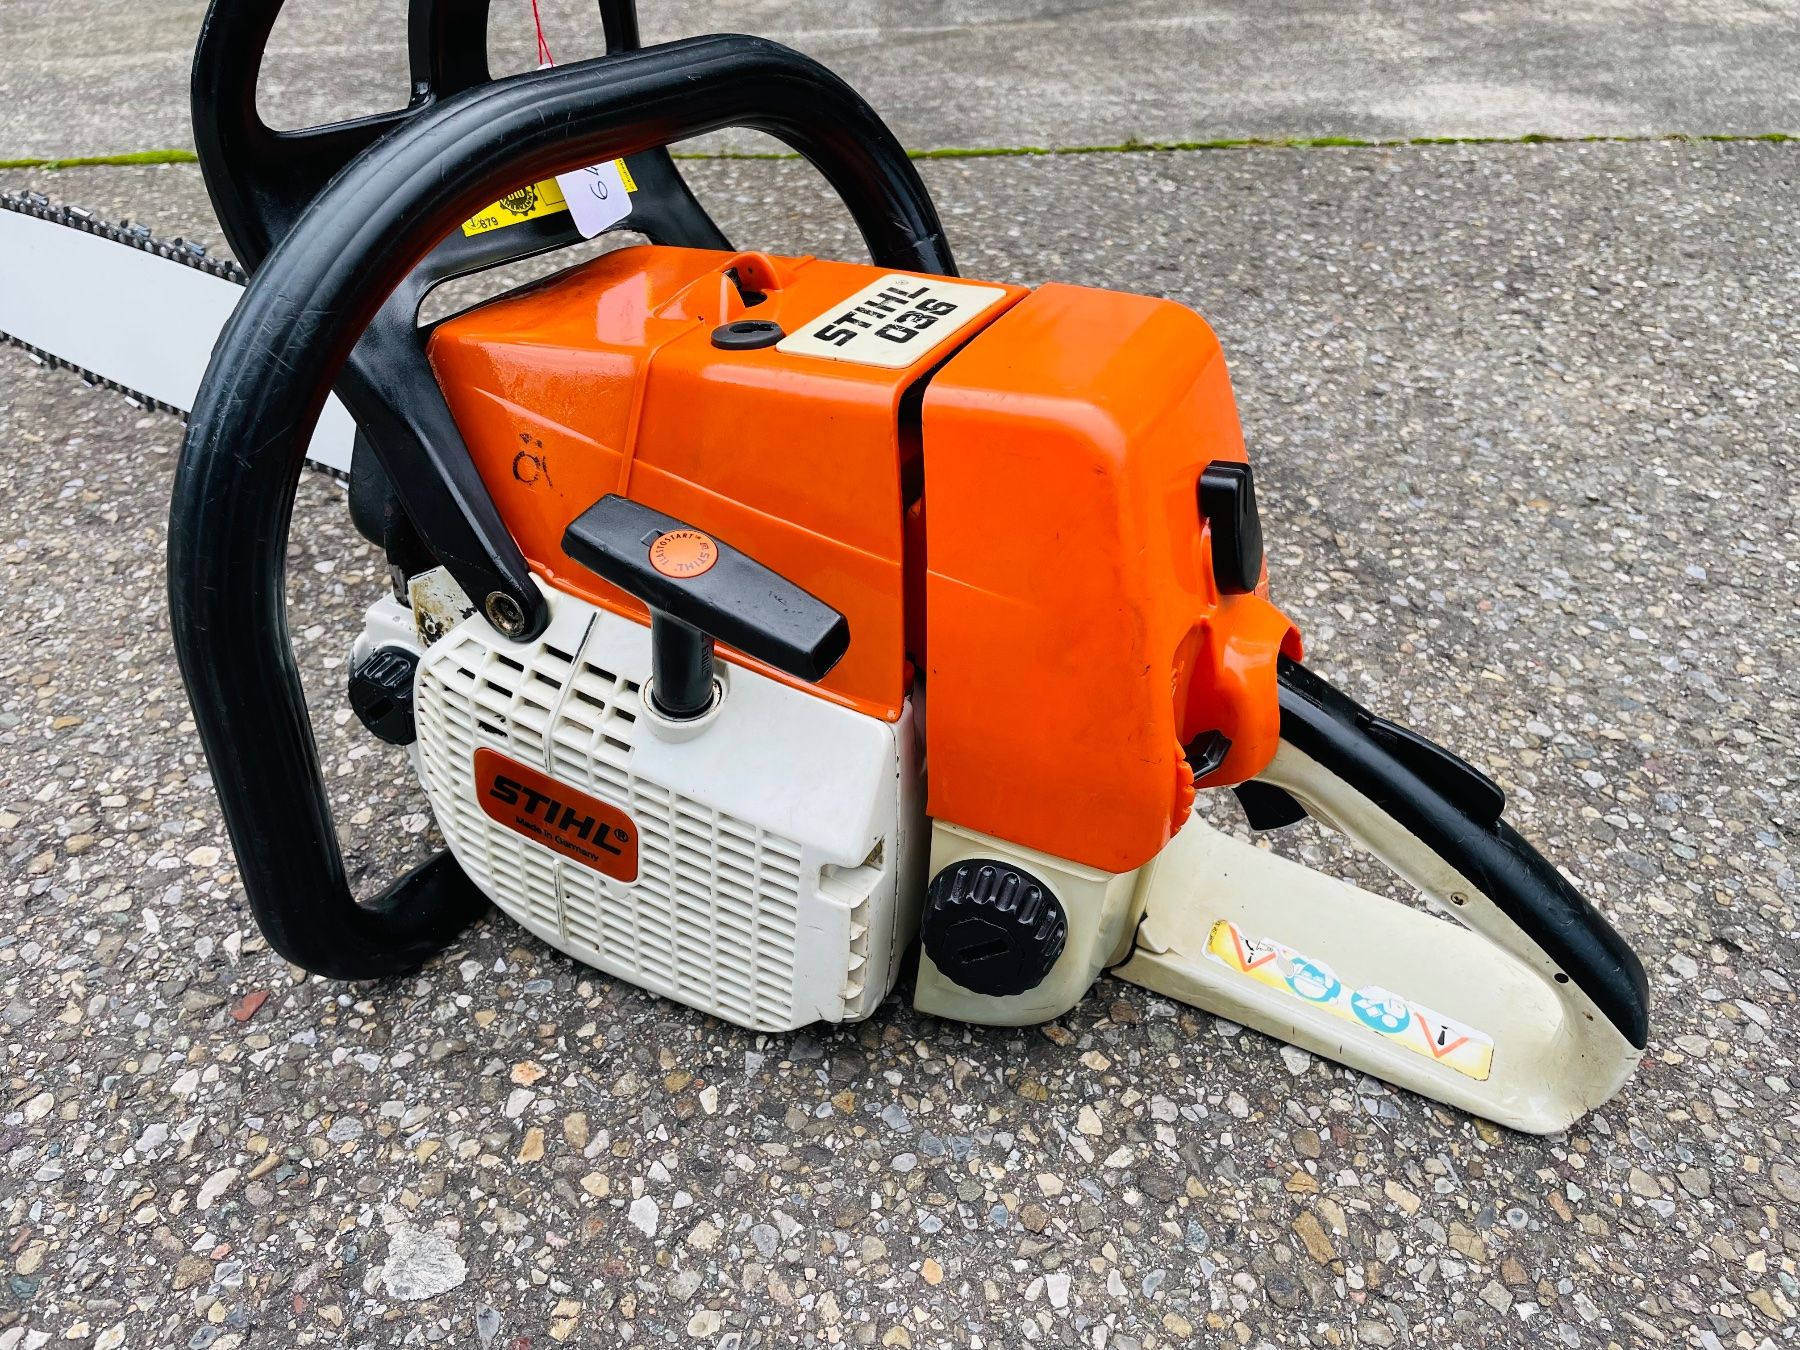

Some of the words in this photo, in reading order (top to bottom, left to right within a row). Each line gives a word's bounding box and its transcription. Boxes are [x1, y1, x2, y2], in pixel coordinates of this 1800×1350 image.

[813, 286, 931, 347] STIHL
[515, 815, 543, 835] Made
[544, 830, 553, 840] in
[554, 834, 600, 863] Germany
